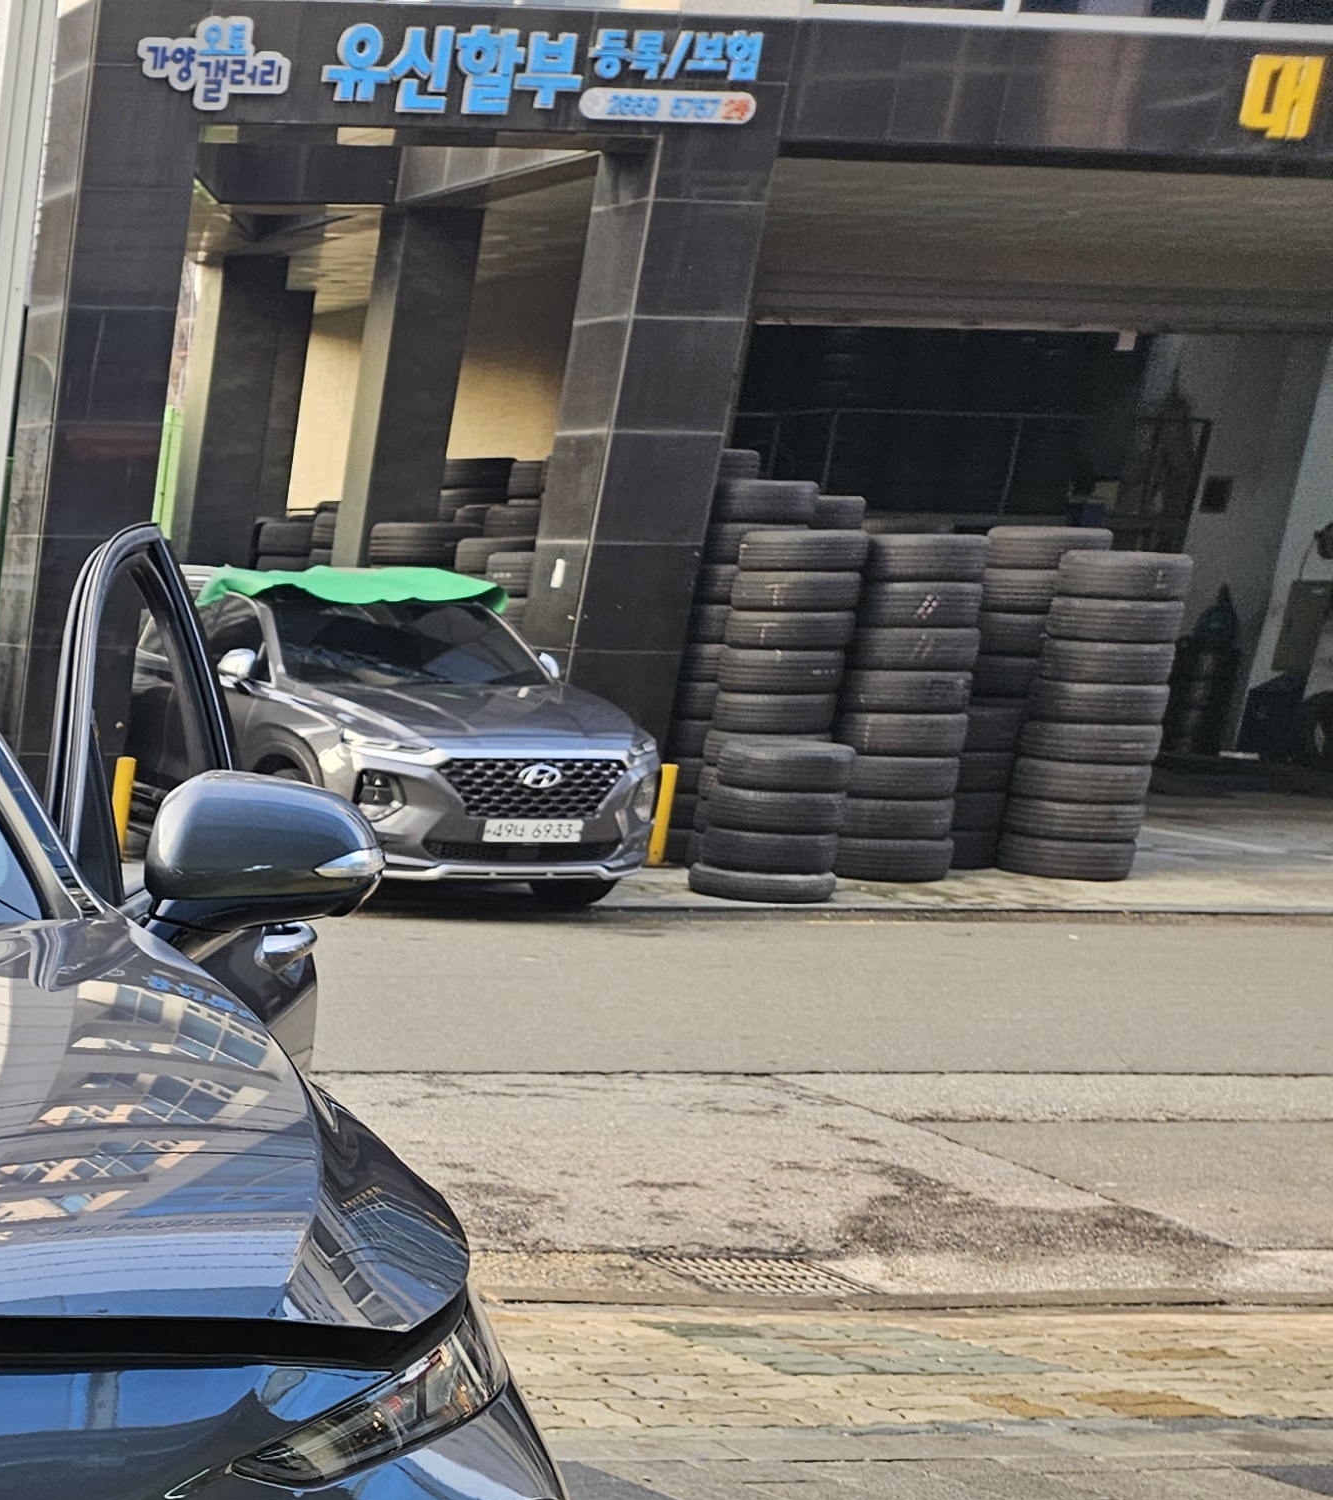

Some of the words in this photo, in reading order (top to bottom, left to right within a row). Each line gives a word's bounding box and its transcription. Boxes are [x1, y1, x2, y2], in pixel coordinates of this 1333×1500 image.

[198, 24, 248, 56] 오토
[589, 28, 764, 81] 등록/보험
[146, 45, 197, 82] 가양
[197, 59, 282, 102] 갤러리
[321, 23, 583, 115] 유신할부
[1238, 54, 1326, 140] 대
[531, 822, 574, 839] 6933
